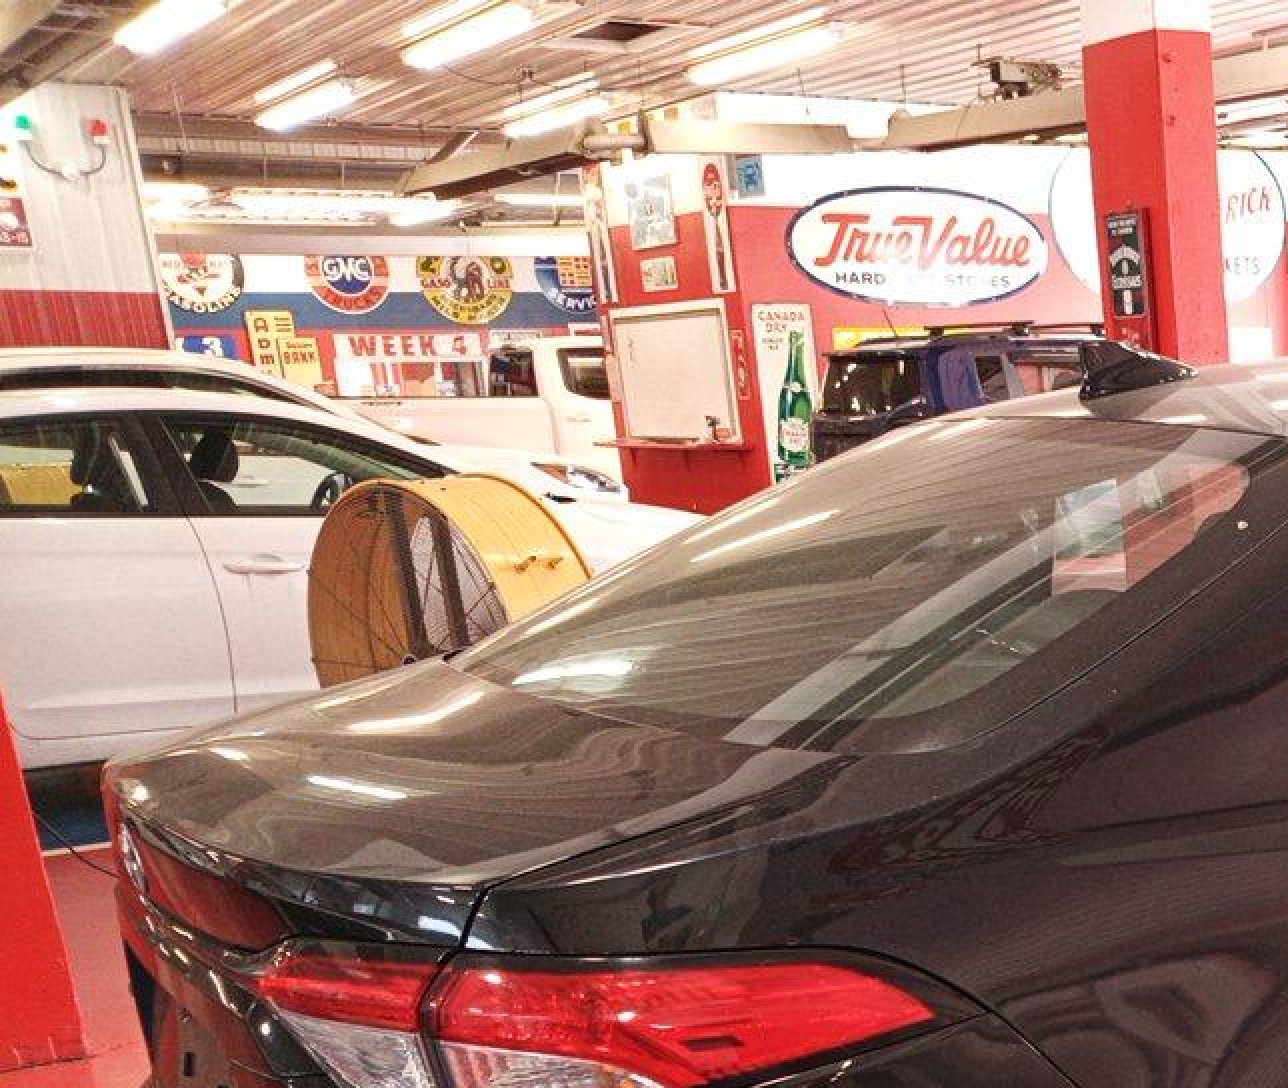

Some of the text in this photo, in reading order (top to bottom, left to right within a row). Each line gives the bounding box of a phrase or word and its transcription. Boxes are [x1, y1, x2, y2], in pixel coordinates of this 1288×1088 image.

[322, 255, 373, 281] GMC
[943, 274, 1011, 289] STOES
[758, 311, 804, 321] CANADA
[348, 335, 436, 357] WEEK
